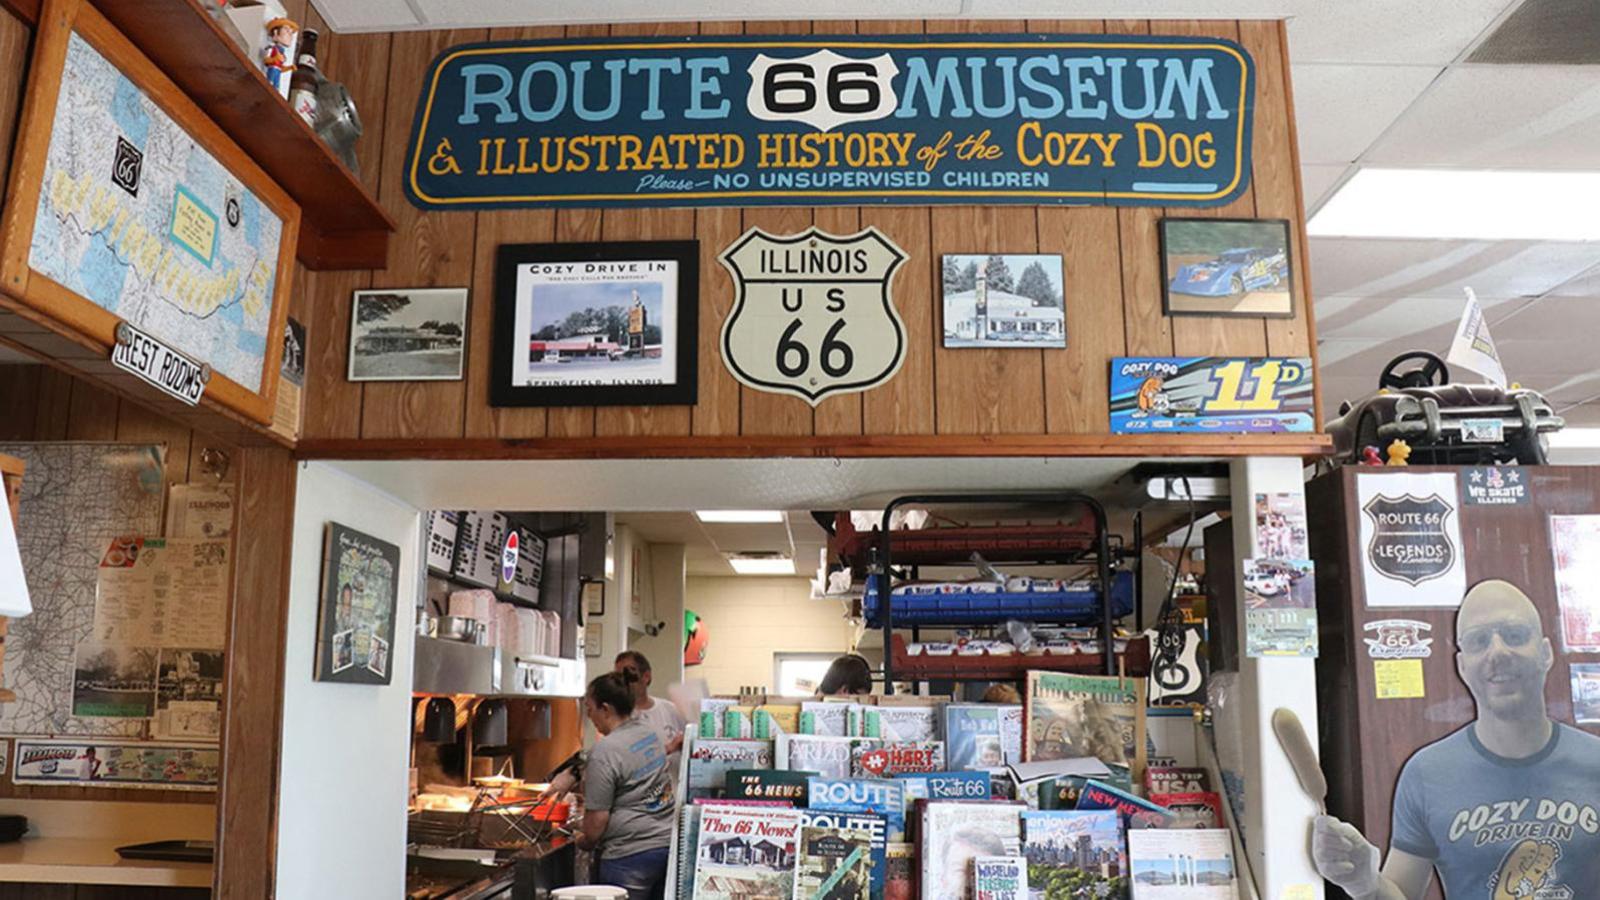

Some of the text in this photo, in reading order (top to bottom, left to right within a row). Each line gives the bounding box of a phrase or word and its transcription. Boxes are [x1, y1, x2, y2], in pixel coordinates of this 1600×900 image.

[457, 54, 1230, 125] ROUTE 66 MUSEUM
[428, 122, 1218, 176] & ILLUSTRATED HISTORY of the COZY DOG
[118, 157, 137, 184] 66
[713, 173, 750, 189] NO
[759, 171, 931, 189] UNSUPERVISED
[942, 171, 1050, 188] CHILDREN
[530, 262, 667, 275] COZY DRIVE IN
[760, 249, 868, 274] ILLINOIS
[782, 288, 846, 312] U S
[776, 318, 854, 378] 66
[119, 330, 202, 400] REST ROOMS
[1121, 362, 1153, 376] COZY
[1468, 484, 1524, 498] WE SKATE
[1378, 512, 1440, 525] ROUTE 66
[1379, 544, 1444, 558] LEGENDS
[1386, 634, 1411, 647] 66
[741, 775, 761, 784] THE
[964, 779, 986, 796] 66
[1151, 780, 1204, 795] USA
[744, 784, 804, 798] 66 NEWS
[811, 781, 901, 811] ROUTE
[1058, 788, 1076, 800] 66
[1087, 788, 1118, 808] NEW
[703, 816, 732, 834] The
[734, 820, 753, 835] 66
[1449, 797, 1600, 842] COZY DOG
[1474, 821, 1574, 847] DRIVE IN
